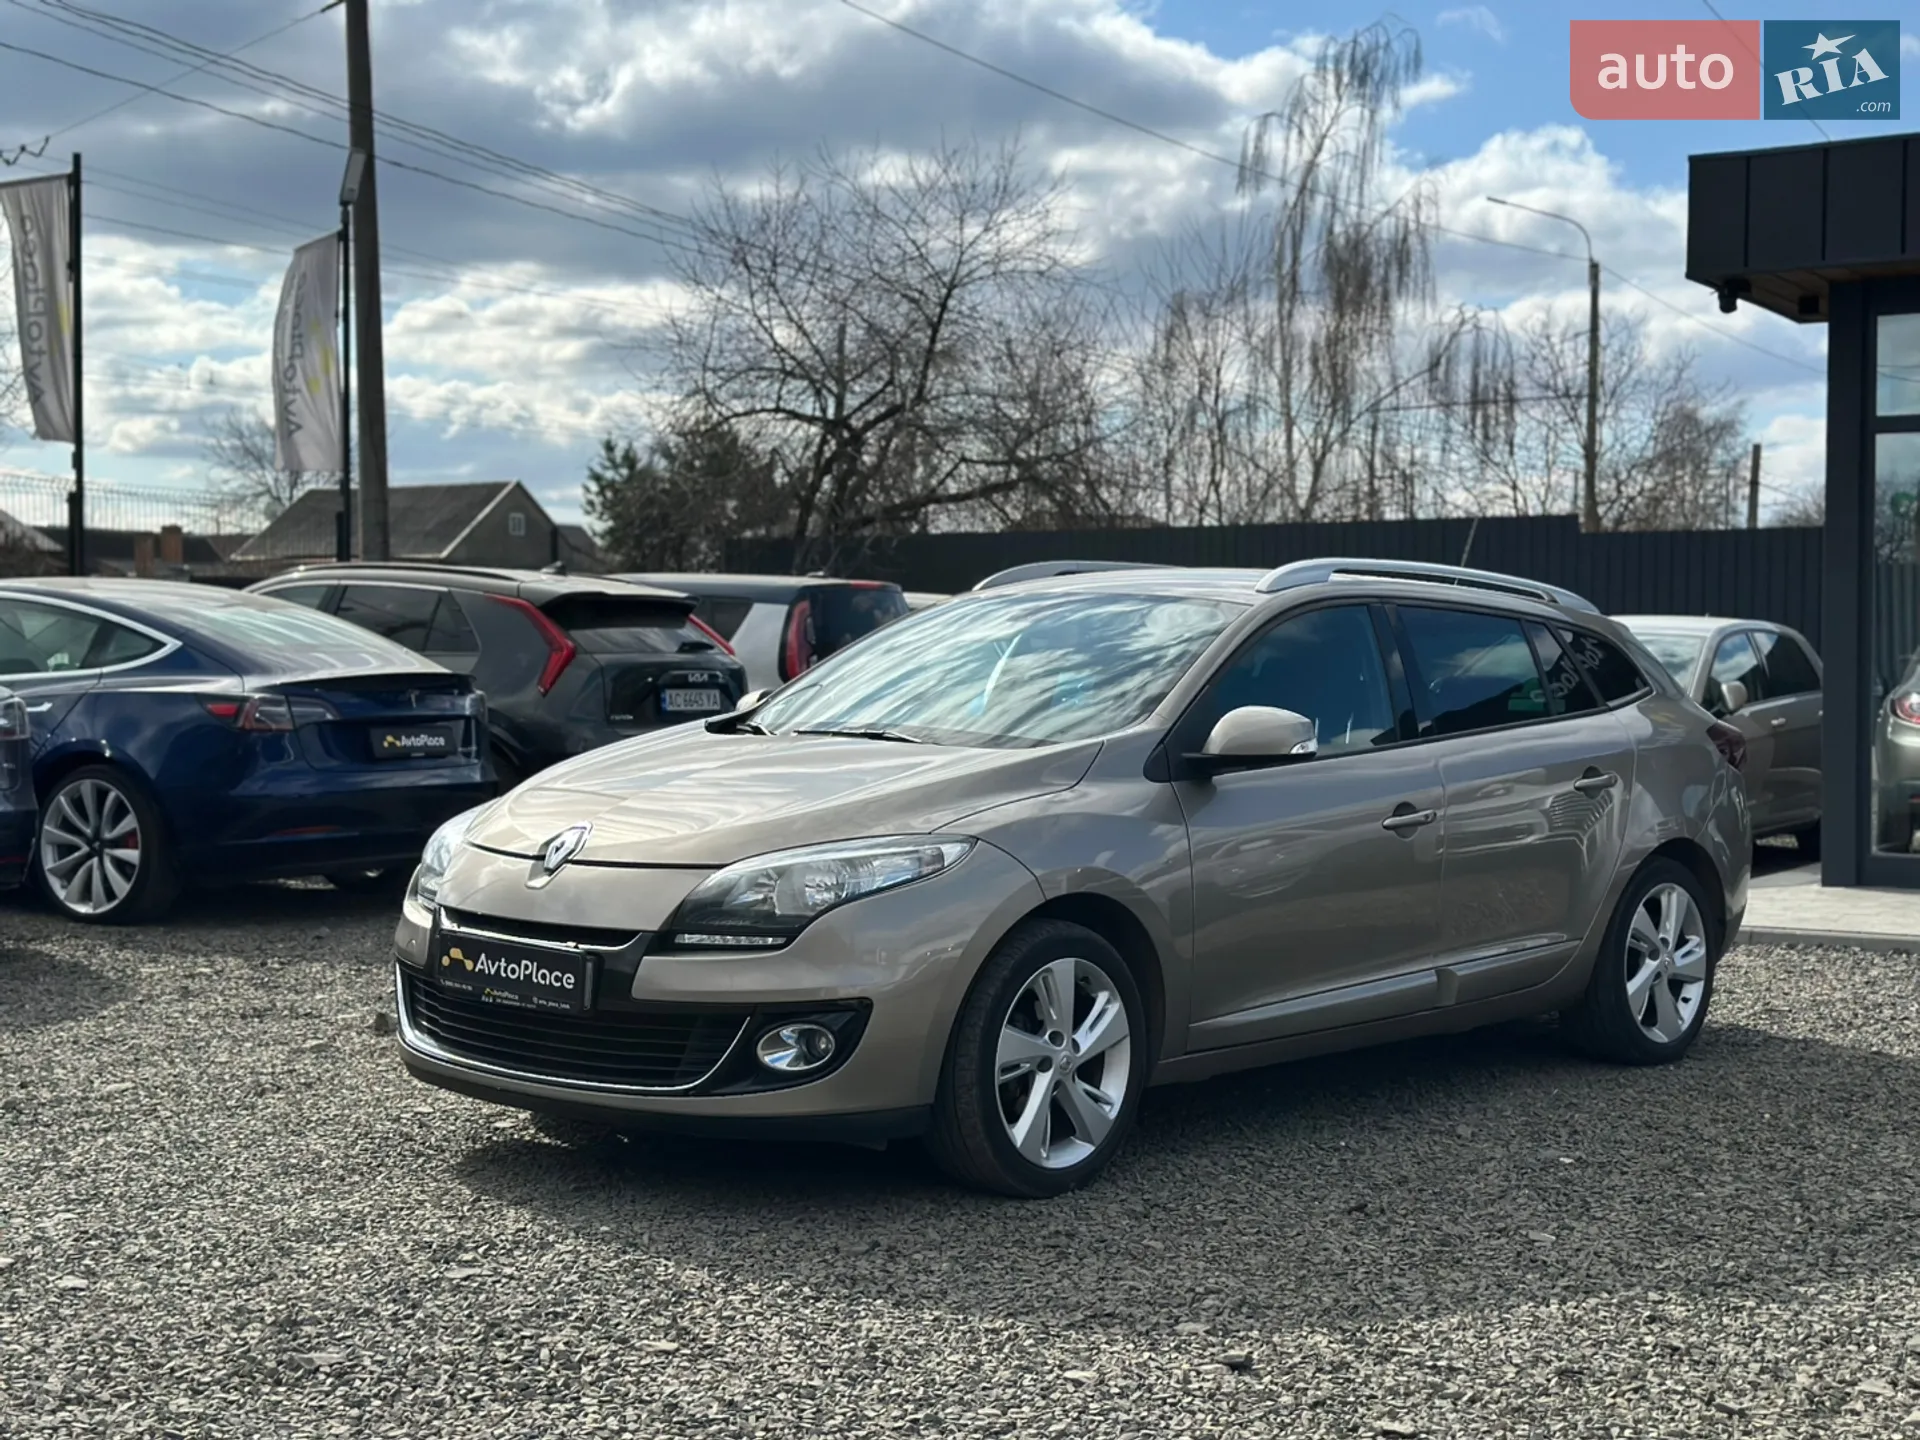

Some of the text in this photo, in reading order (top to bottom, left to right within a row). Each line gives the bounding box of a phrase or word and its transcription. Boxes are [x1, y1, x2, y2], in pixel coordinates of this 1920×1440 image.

[668, 692, 681, 708] AC
[401, 734, 445, 747] AvtoPlace
[474, 952, 575, 989] AvtoPlace
